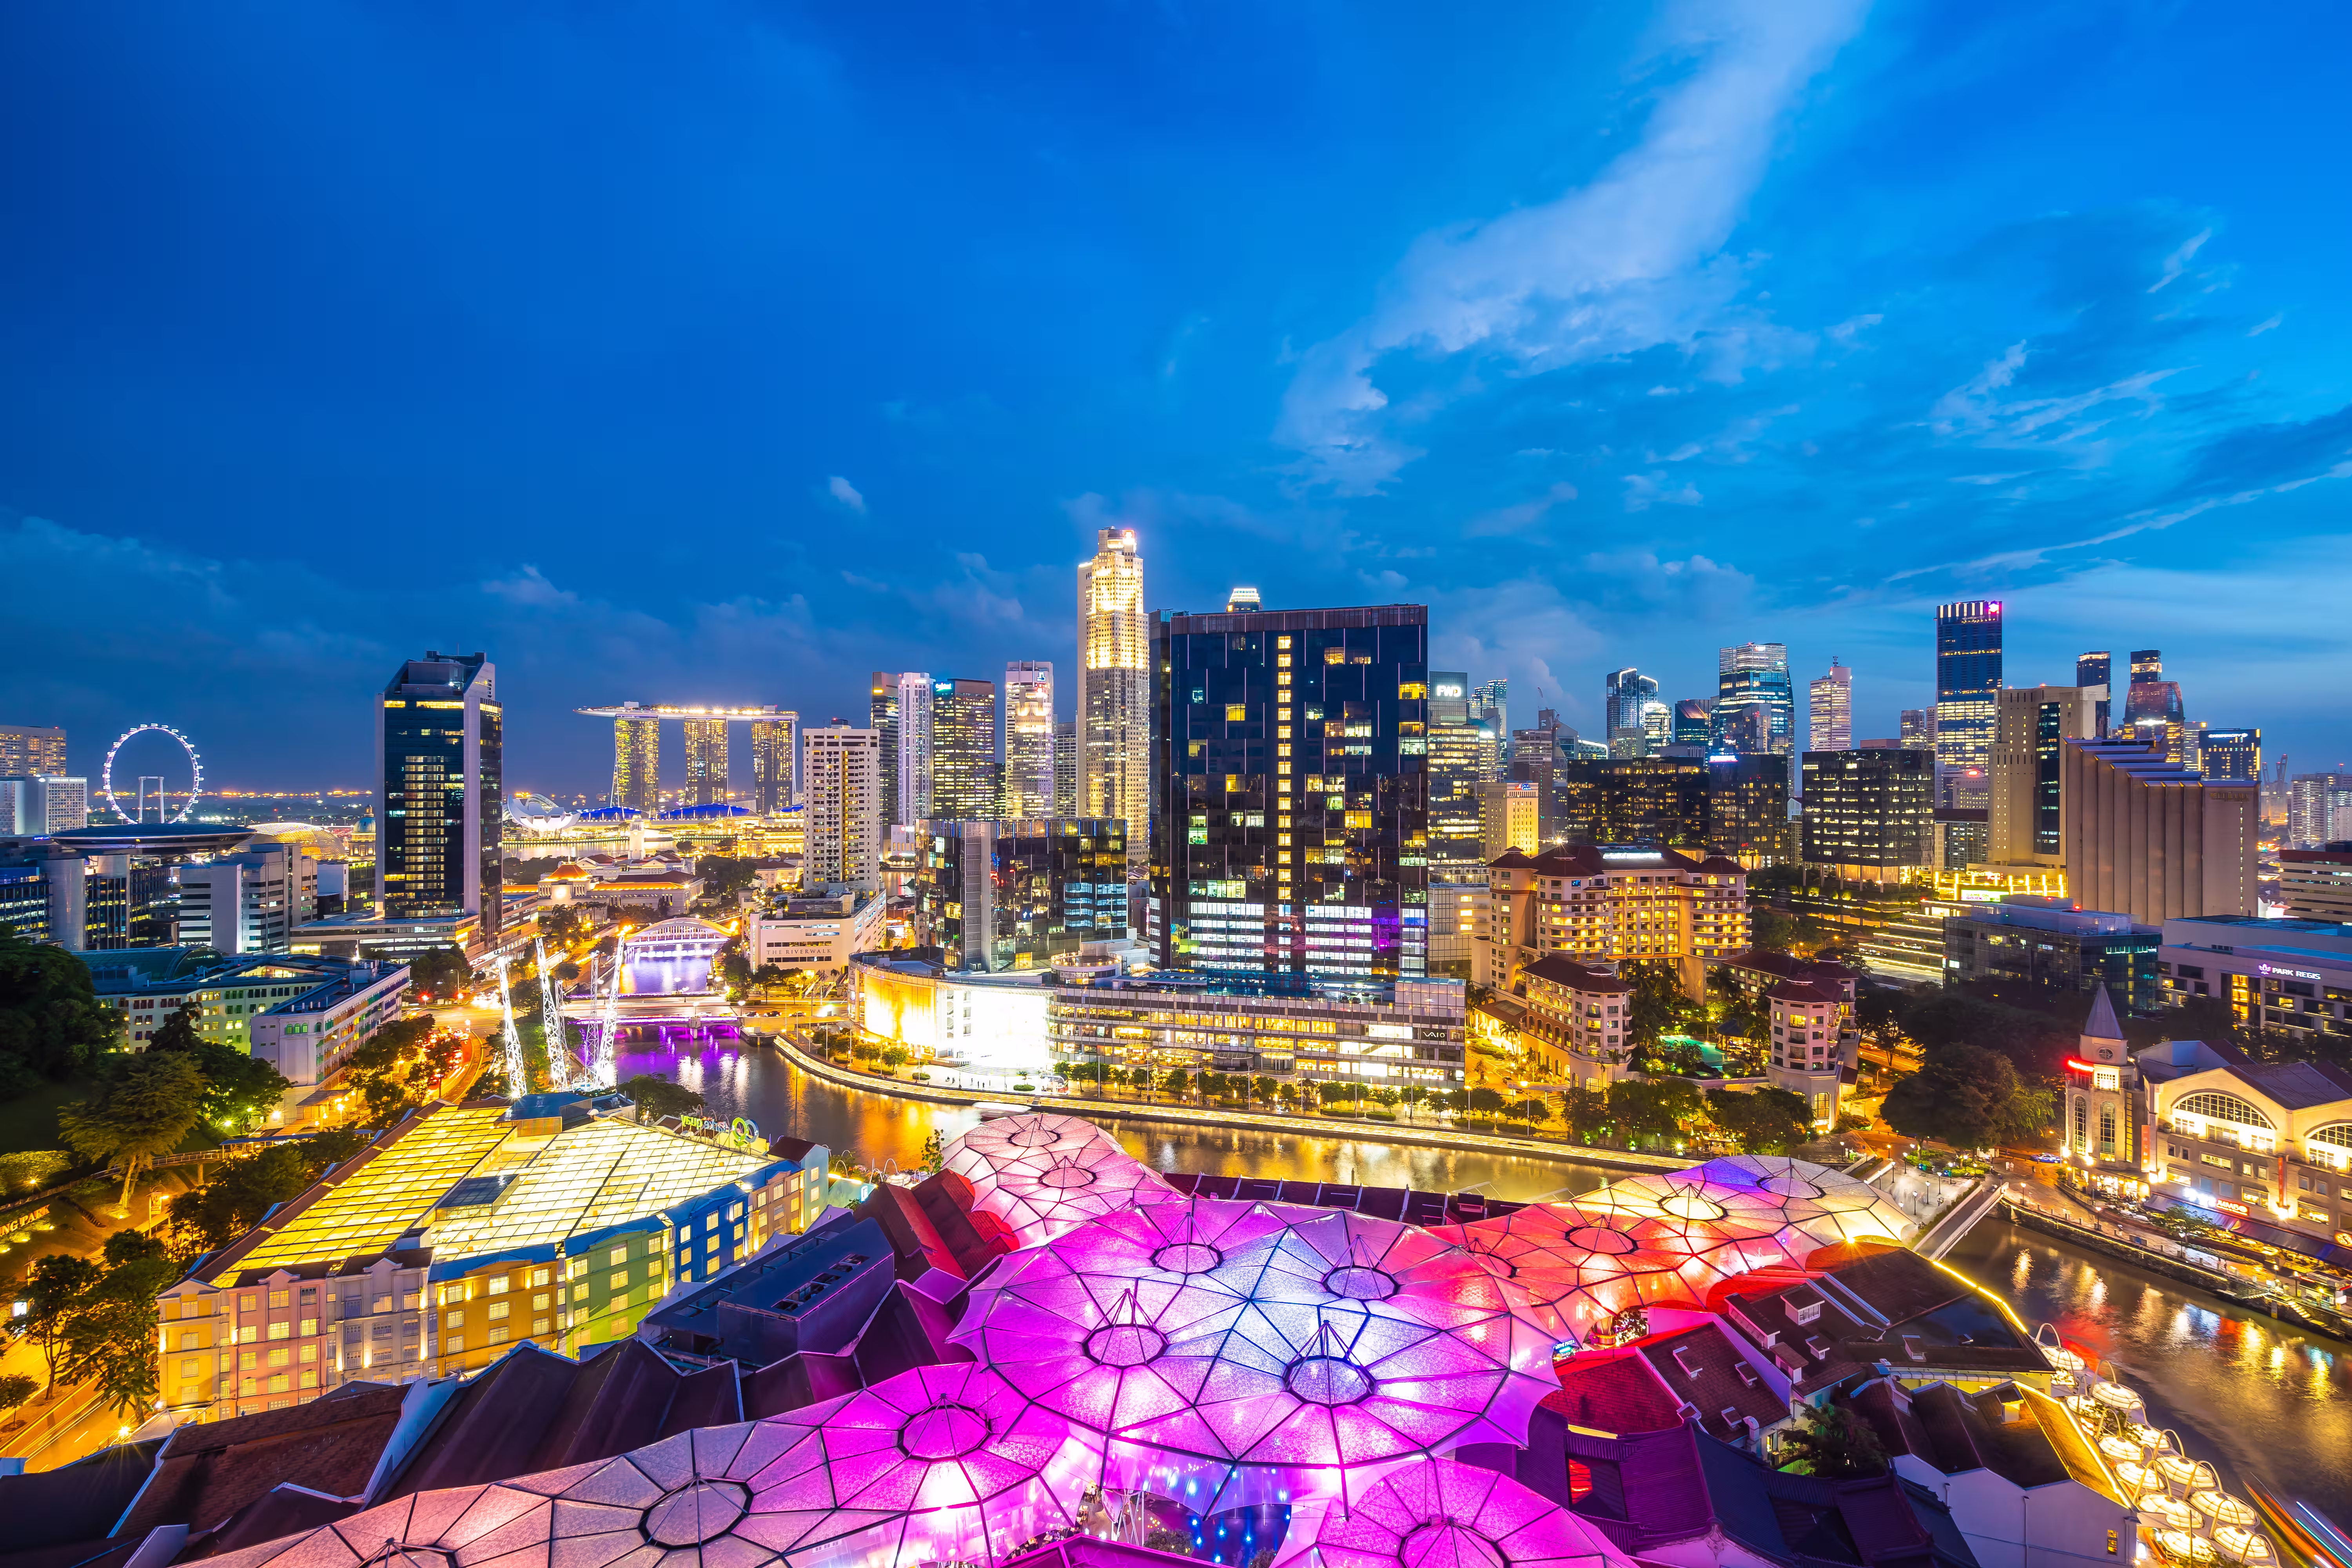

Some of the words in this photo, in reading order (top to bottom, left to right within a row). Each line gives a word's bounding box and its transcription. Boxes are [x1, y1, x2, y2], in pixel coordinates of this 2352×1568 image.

[1437, 685, 1461, 697] FWD
[2272, 967, 2294, 976] PARK
[2296, 971, 2321, 980] REGIS
[2217, 1199, 2248, 1213] JUMBO
[19, 1204, 50, 1227] PARK
